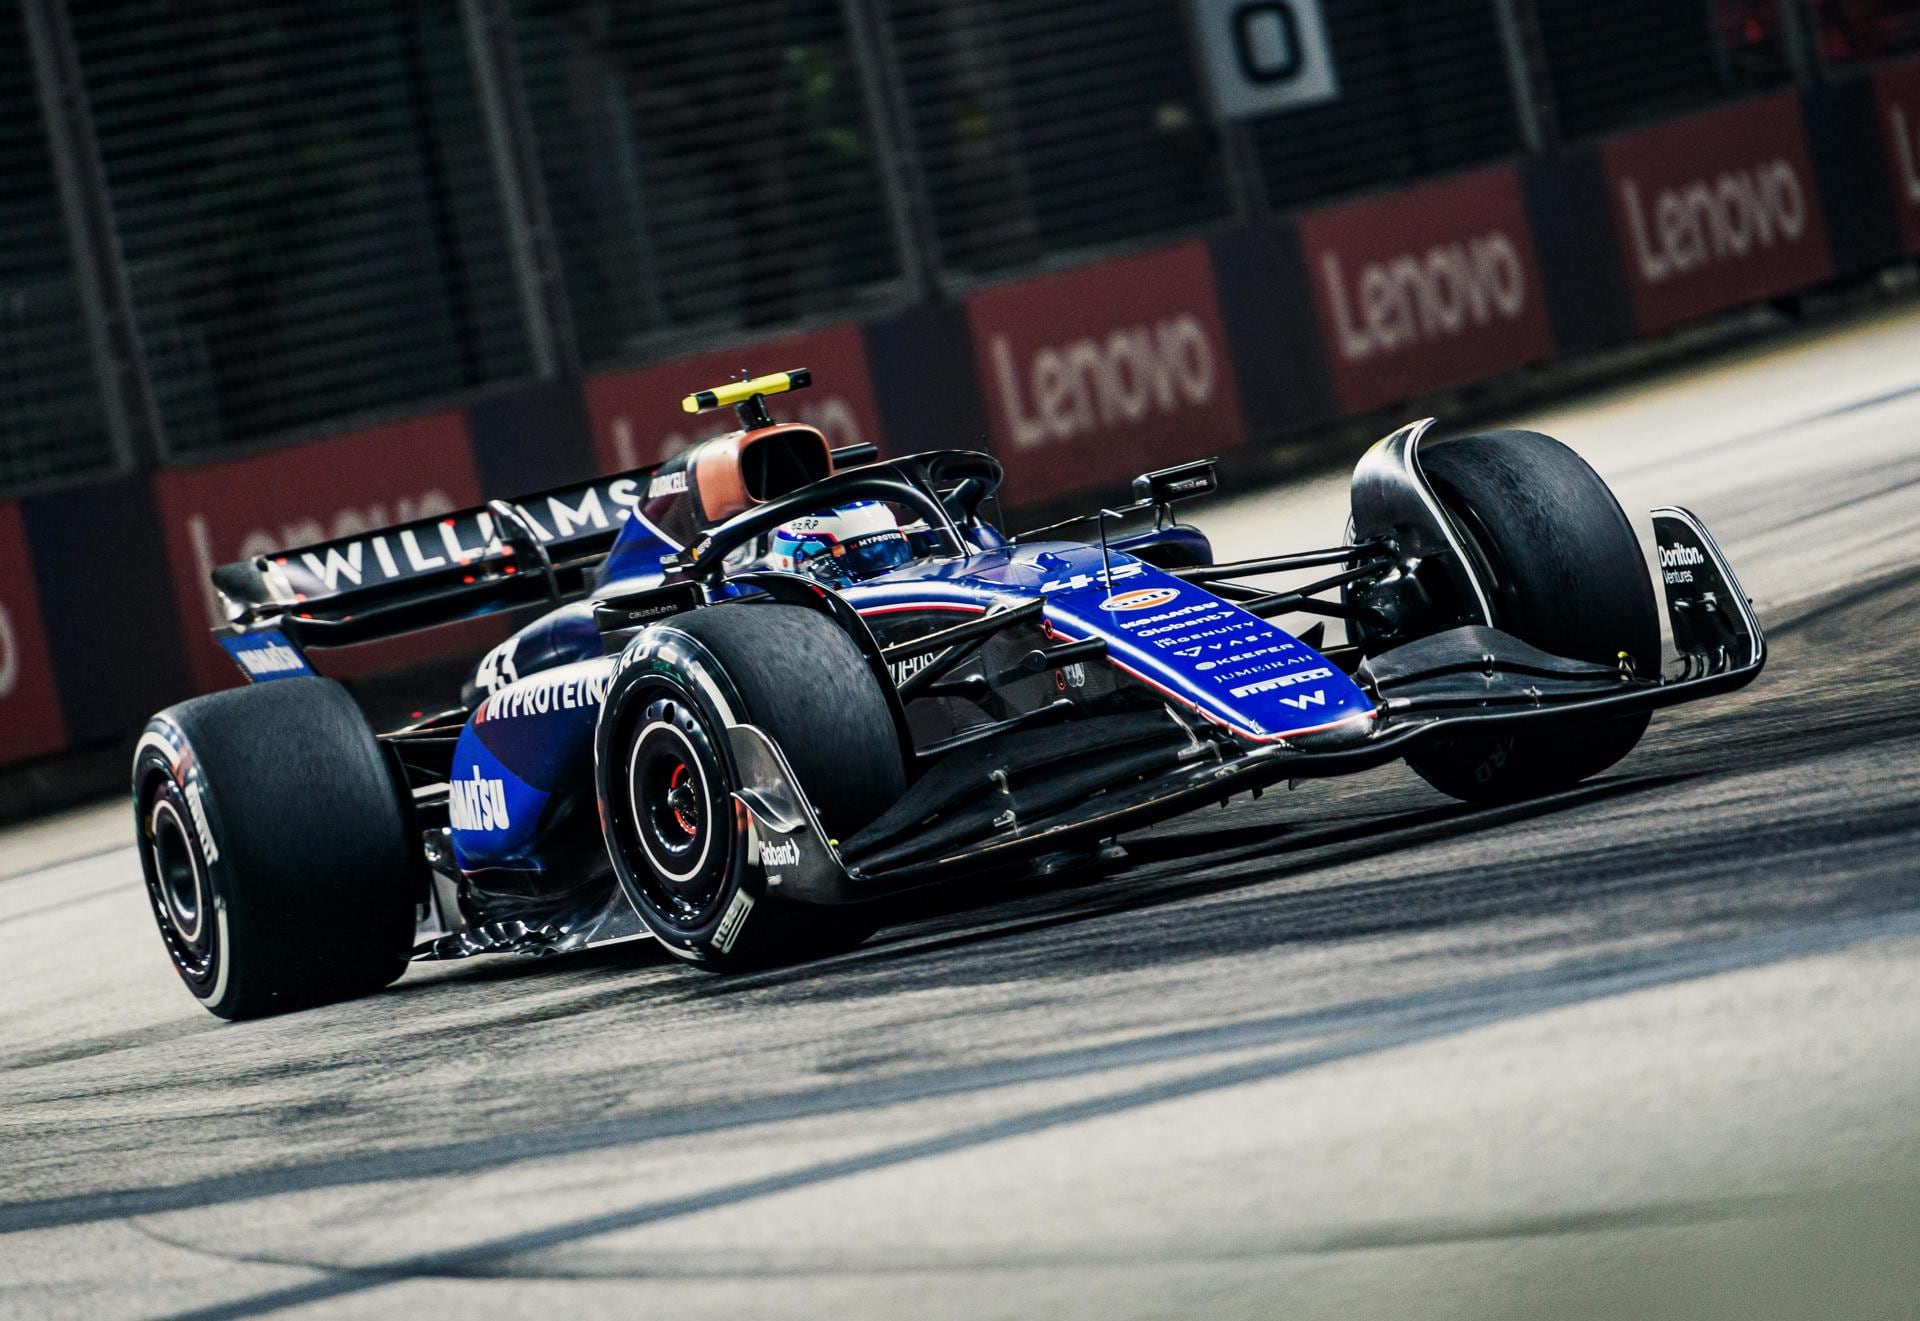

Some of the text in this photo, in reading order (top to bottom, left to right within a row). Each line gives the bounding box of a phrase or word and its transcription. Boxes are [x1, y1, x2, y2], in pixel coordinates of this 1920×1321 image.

[1622, 159, 1805, 279] Lenovo
[1321, 233, 1523, 361] Lenovo
[991, 313, 1213, 447] Lenovo
[1663, 569, 1693, 584] Ventures
[628, 604, 678, 619] causaLens
[1137, 613, 1222, 637] Globant
[1208, 631, 1273, 650] VAST
[1216, 643, 1296, 665] KEEPER
[475, 637, 519, 696] 43
[485, 676, 606, 721] MYPROTEIN
